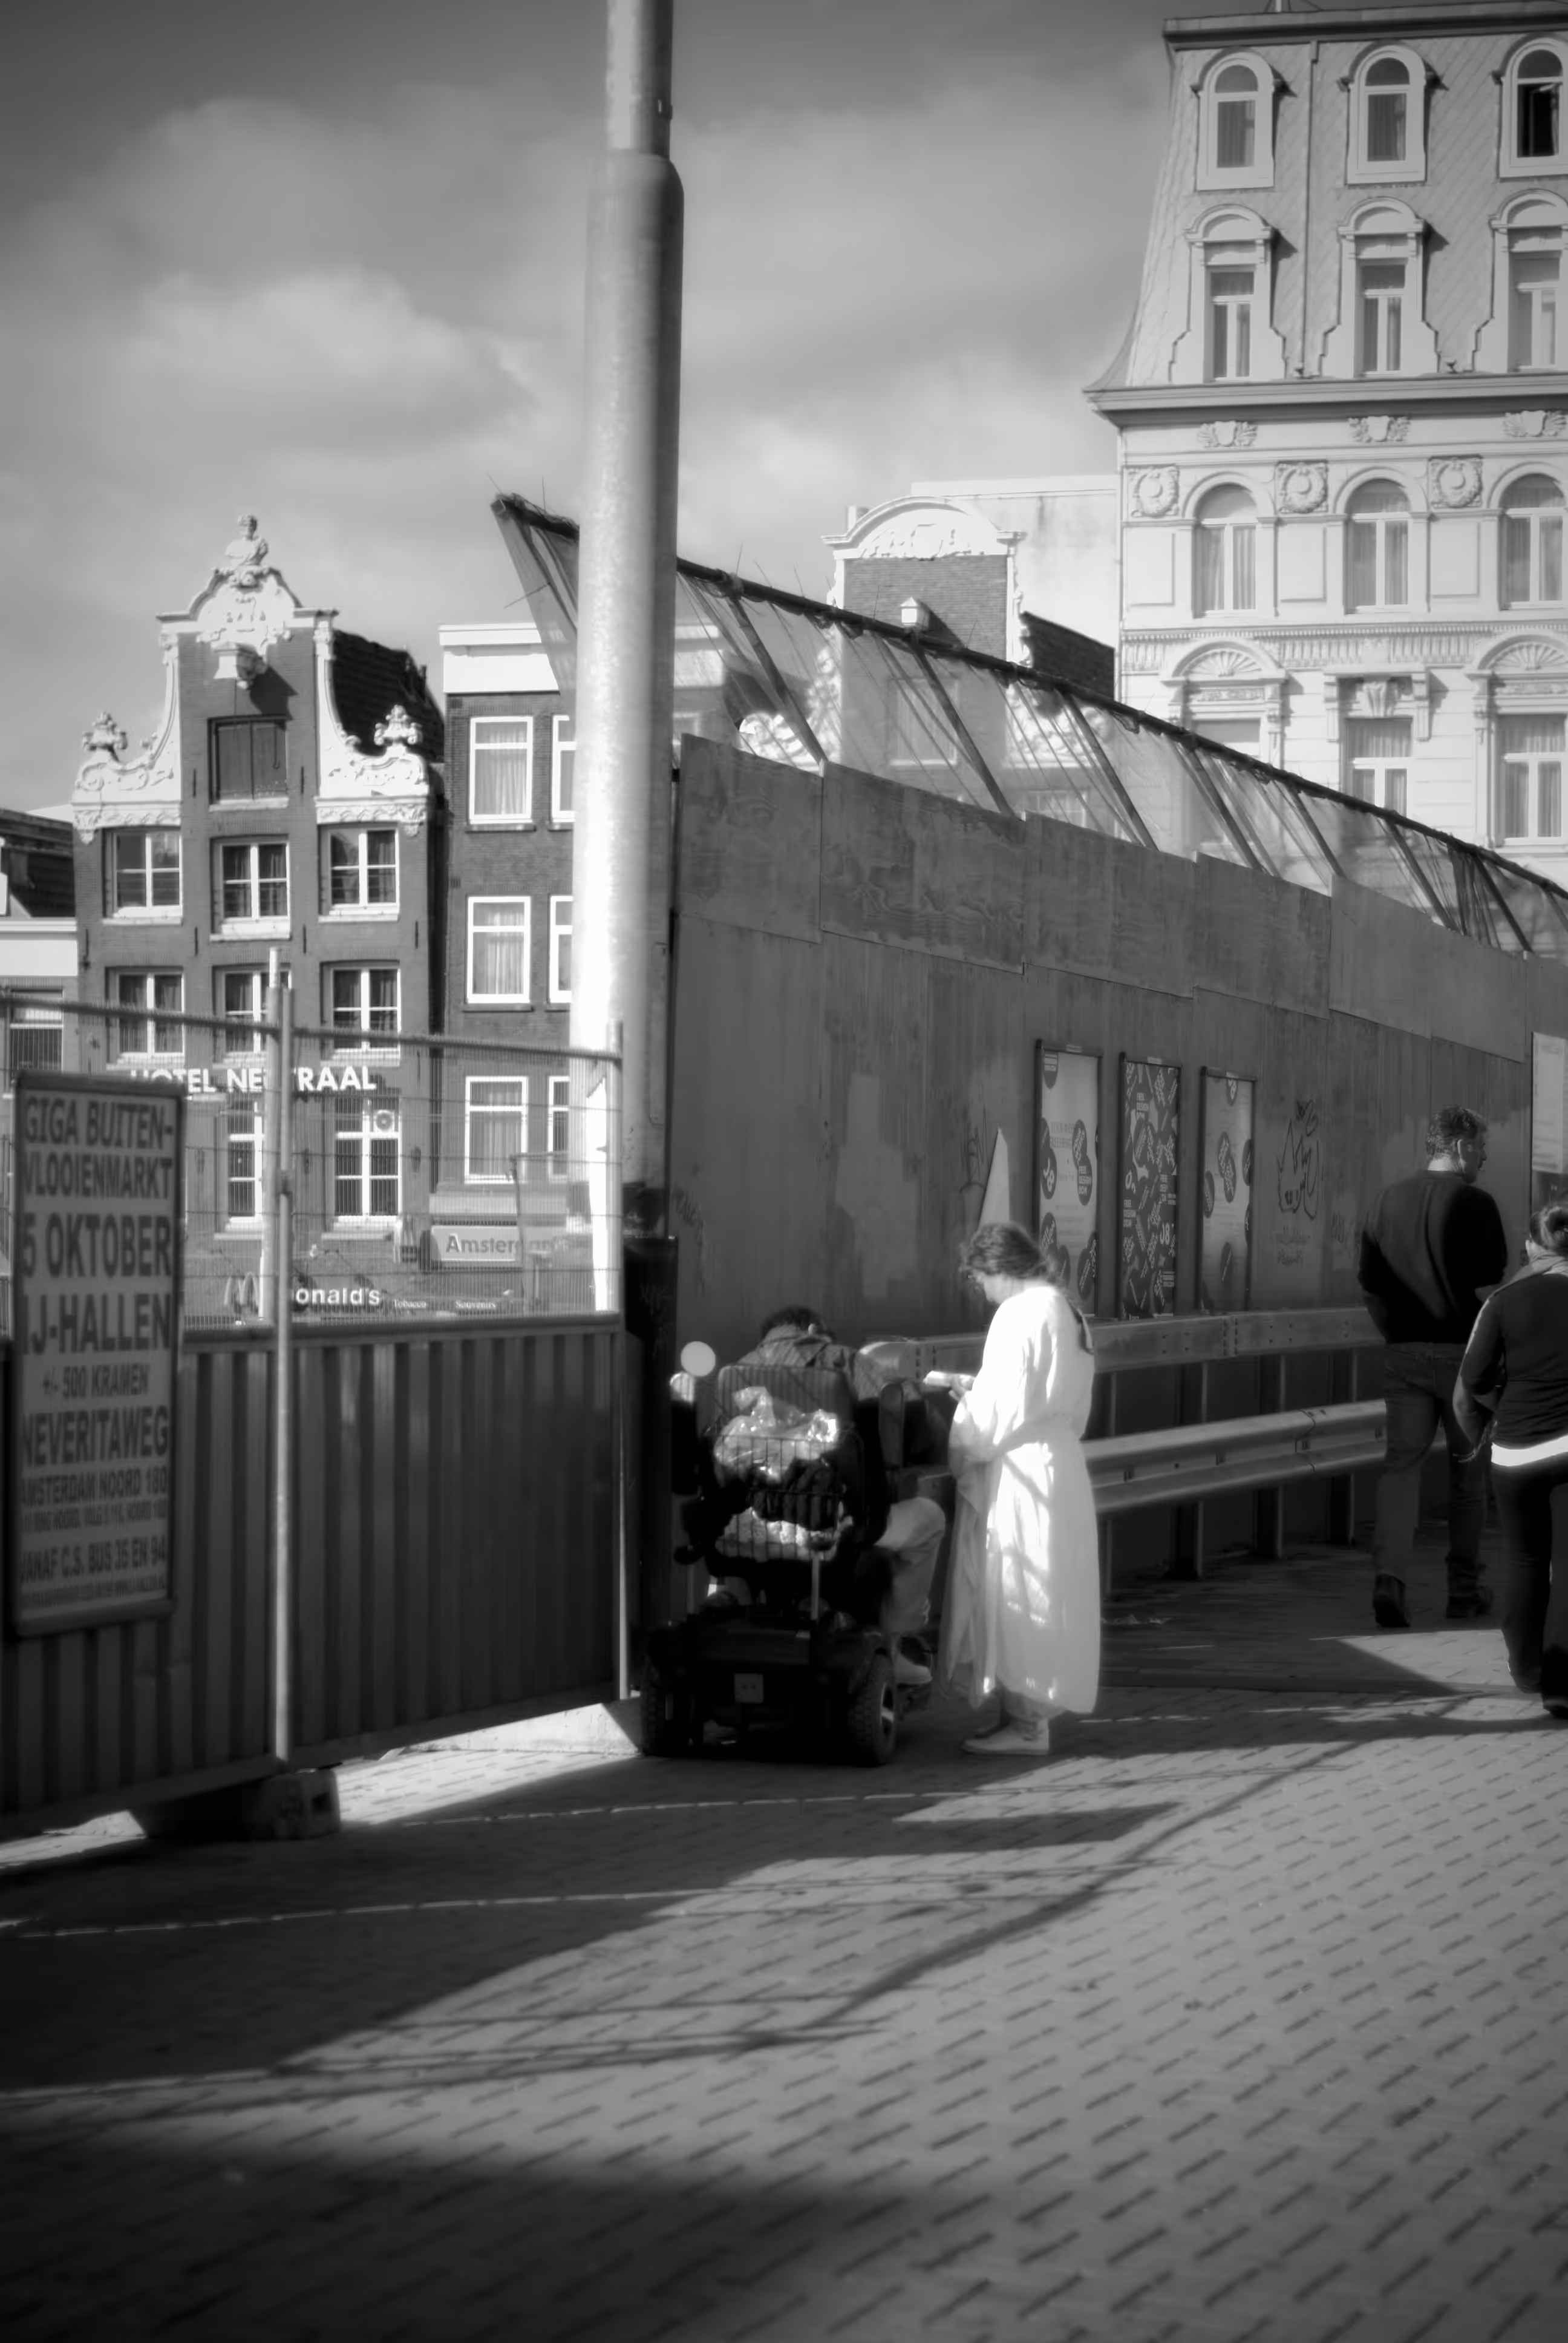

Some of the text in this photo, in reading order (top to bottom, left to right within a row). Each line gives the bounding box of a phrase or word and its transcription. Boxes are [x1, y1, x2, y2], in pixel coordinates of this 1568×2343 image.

[227, 1066, 377, 1092] NERAAL
[25, 1096, 174, 1149] GIGA BUITEN-
[23, 1151, 172, 1199] VLOOIENMARKT
[22, 1212, 171, 1278] 5 OKTOBER
[63, 1366, 86, 1397] 500
[91, 1363, 149, 1397] KRAMEN
[22, 1405, 168, 1469] NEVERITAWEG
[99, 1468, 141, 1499] NOORD
[88, 1540, 111, 1574] BUS
